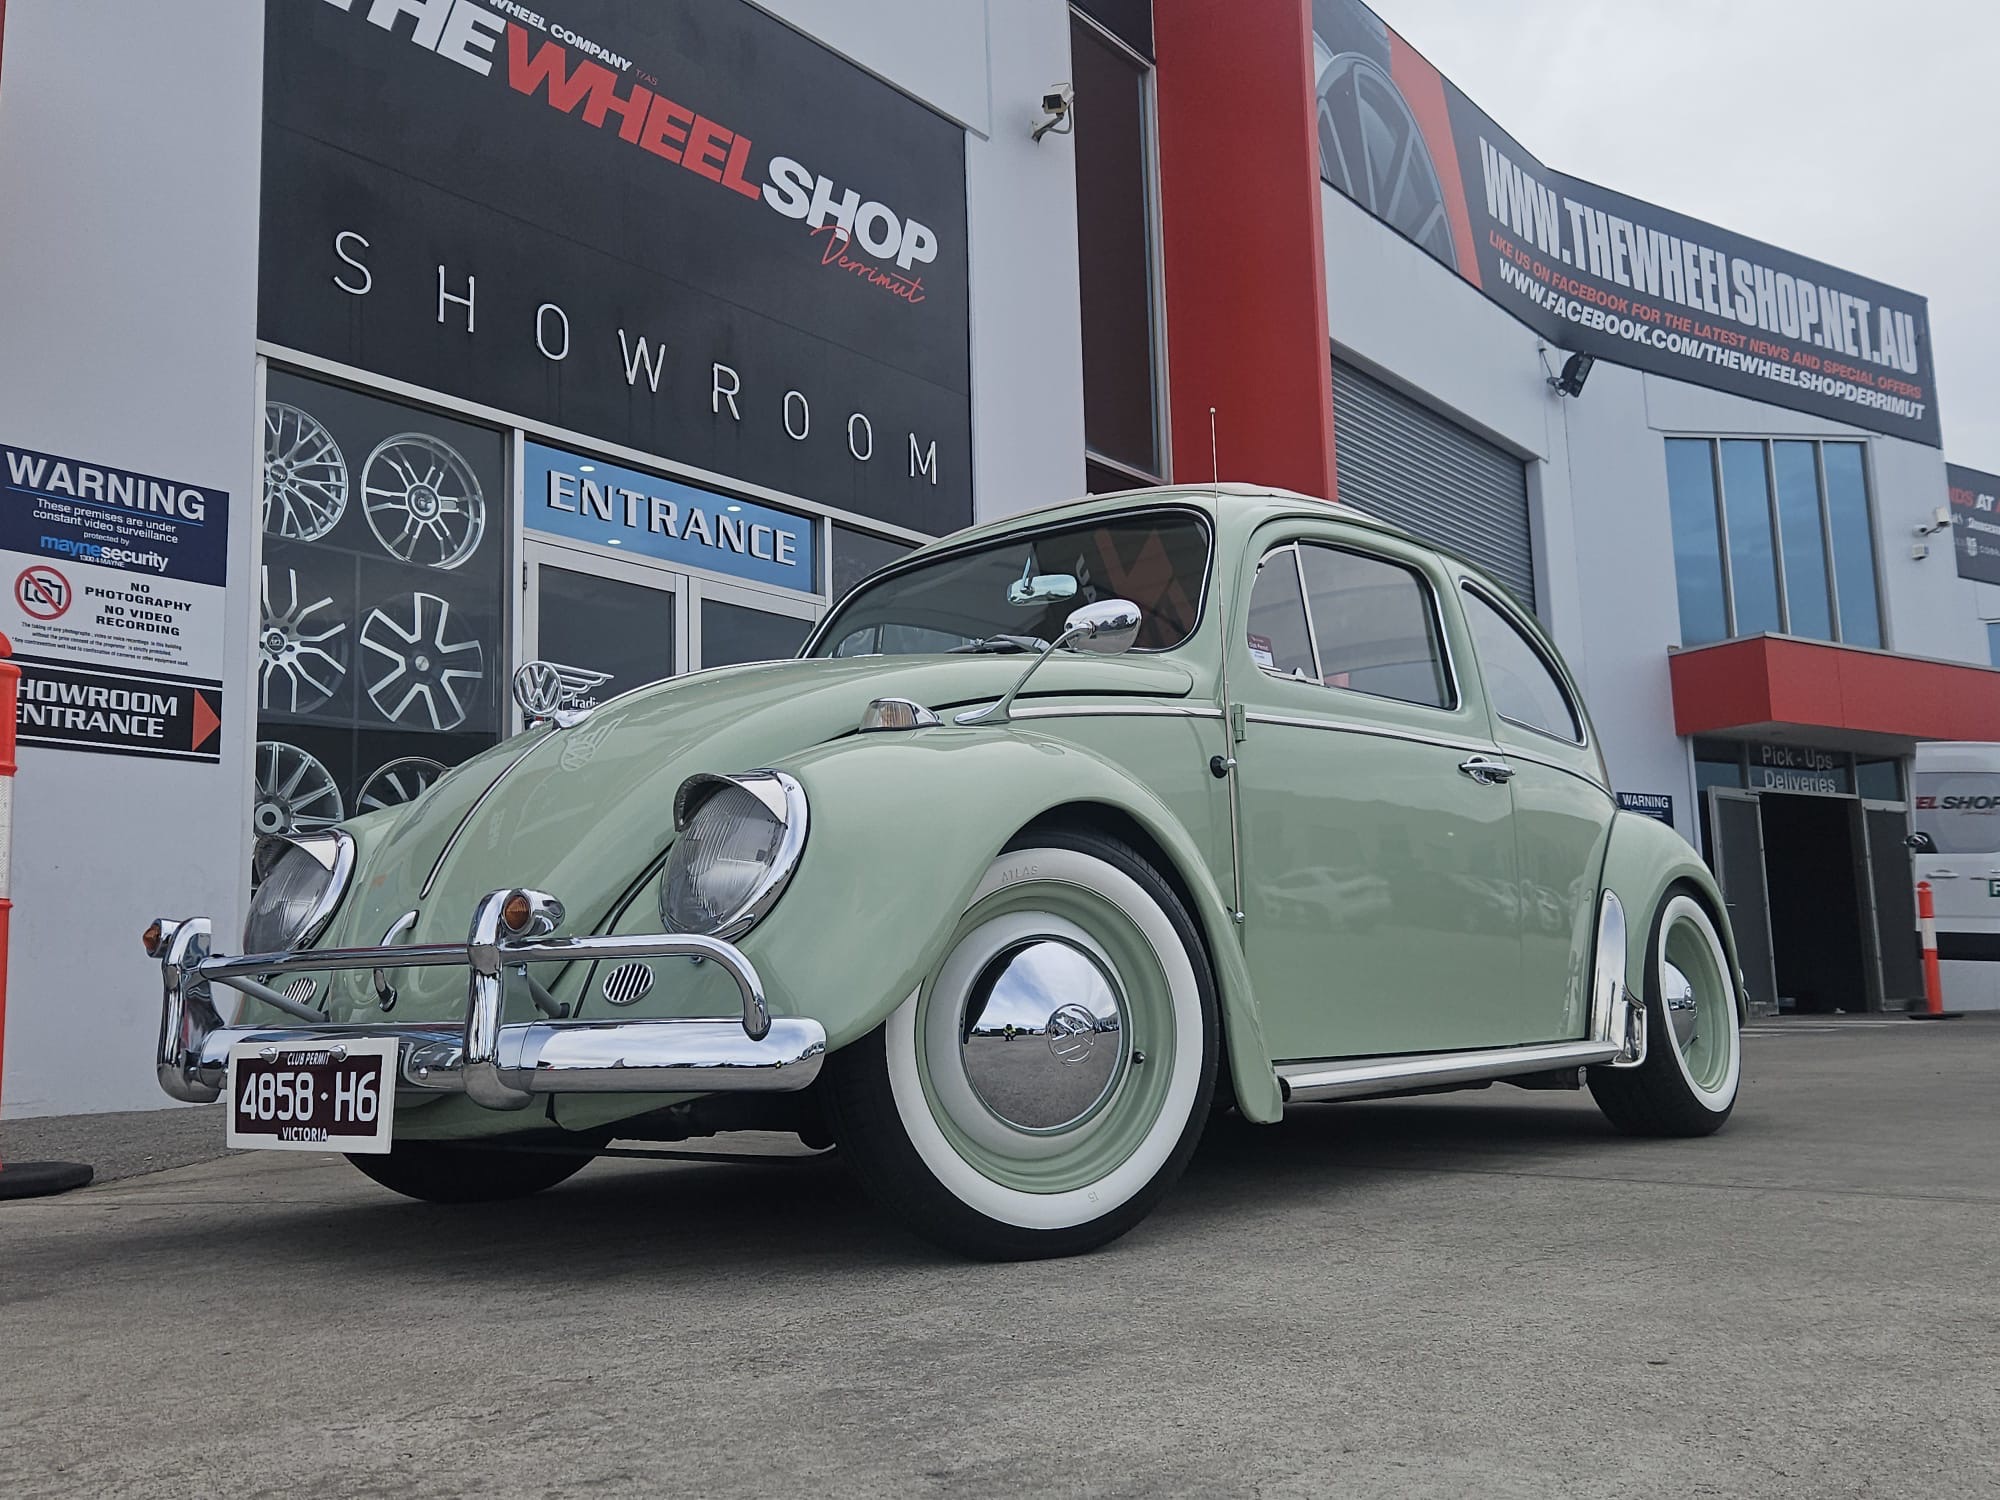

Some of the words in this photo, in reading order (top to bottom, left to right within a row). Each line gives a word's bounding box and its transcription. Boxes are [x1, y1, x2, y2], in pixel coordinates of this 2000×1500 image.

[550, 24, 632, 71] COMPANY
[1479, 136, 1918, 375] WWW.THEWHEELSHOP.NET.AU
[1489, 230, 1513, 258] LIKE
[1515, 250, 1531, 270] US
[1533, 262, 1550, 283] ON
[1552, 272, 1630, 314] FACEBOOK
[1631, 303, 1661, 324] FOR
[1664, 313, 1691, 333] THE
[1694, 322, 1747, 349] LATEST
[1750, 340, 1790, 364] NEWS
[1792, 351, 1821, 370] AND
[1823, 360, 1875, 386] SPECIAL
[1878, 375, 1922, 399] OFFERS
[1499, 258, 1926, 421] WWW.FACEBOOK.COM/THEWHEELSHOPDERRIMUT
[332, 230, 938, 486] SHOWROOM
[6, 452, 205, 521] WARNING
[36, 498, 71, 513] These
[73, 505, 123, 523] premises
[126, 517, 143, 527] are
[145, 520, 176, 533] under
[1976, 493, 1995, 511] AT
[33, 509, 81, 526] constant
[84, 519, 114, 532] video
[116, 525, 178, 544] surveillance
[548, 469, 797, 567] ENTRANCE
[83, 531, 119, 543] protected
[120, 536, 130, 546] by
[85, 586, 192, 612] PHOTOGRAPHY
[130, 582, 150, 593] NO
[96, 615, 180, 636] RECORDING
[104, 605, 124, 616] NO
[129, 609, 172, 623] VIDEO
[16, 679, 178, 717] HOWROOM
[1762, 745, 1795, 767] Pick
[1805, 747, 1833, 773] Ups
[1764, 769, 1836, 794] Deliveries
[1622, 794, 1669, 809] WARNING
[287, 1053, 304, 1066] CLUB
[305, 1051, 330, 1066] PERMIT
[282, 1127, 329, 1142] VICTORIA
